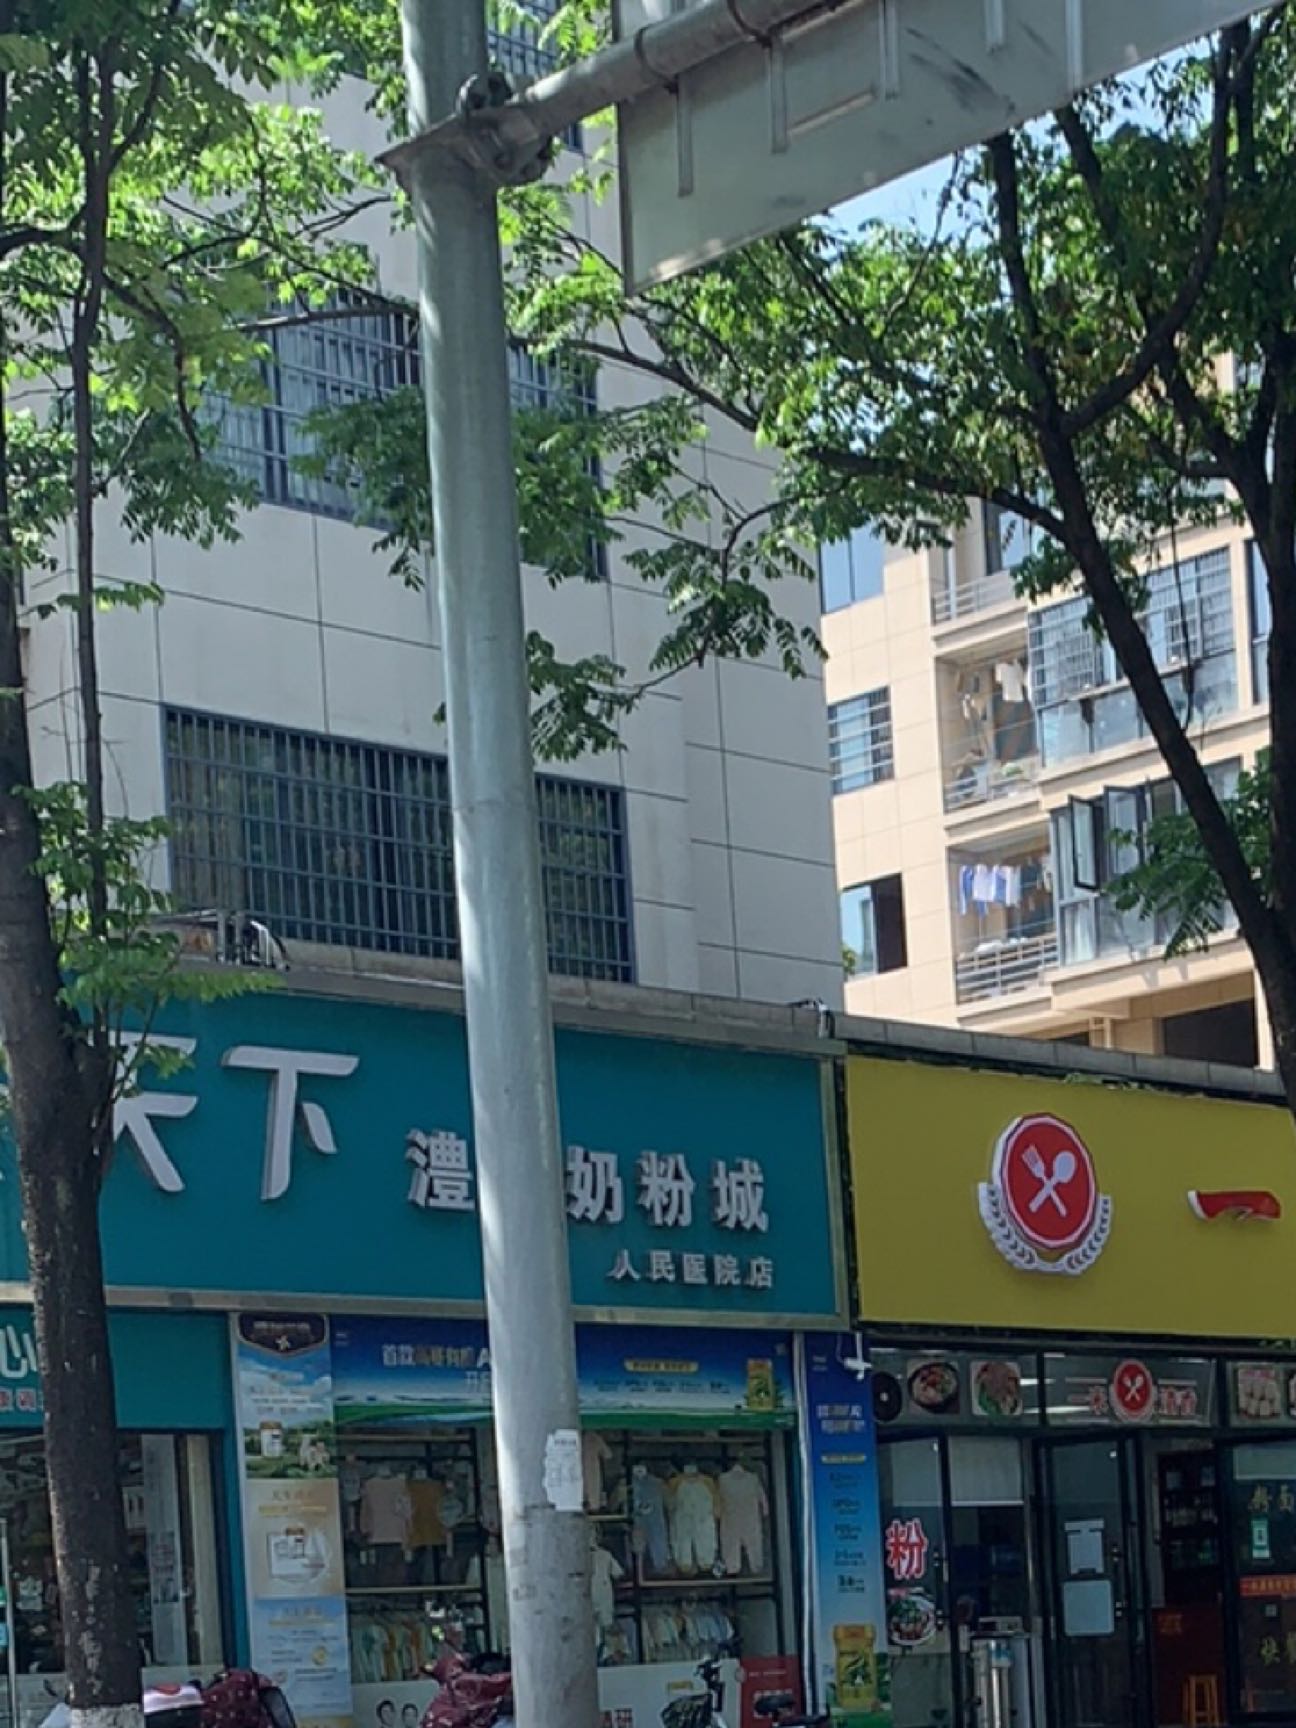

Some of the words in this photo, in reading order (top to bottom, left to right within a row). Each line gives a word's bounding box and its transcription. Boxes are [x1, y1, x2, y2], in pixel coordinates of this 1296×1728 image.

[405, 1127, 768, 1232] 澧奶粉城
[606, 1249, 774, 1288] 人民医院店
[886, 1517, 929, 1580] 粉
